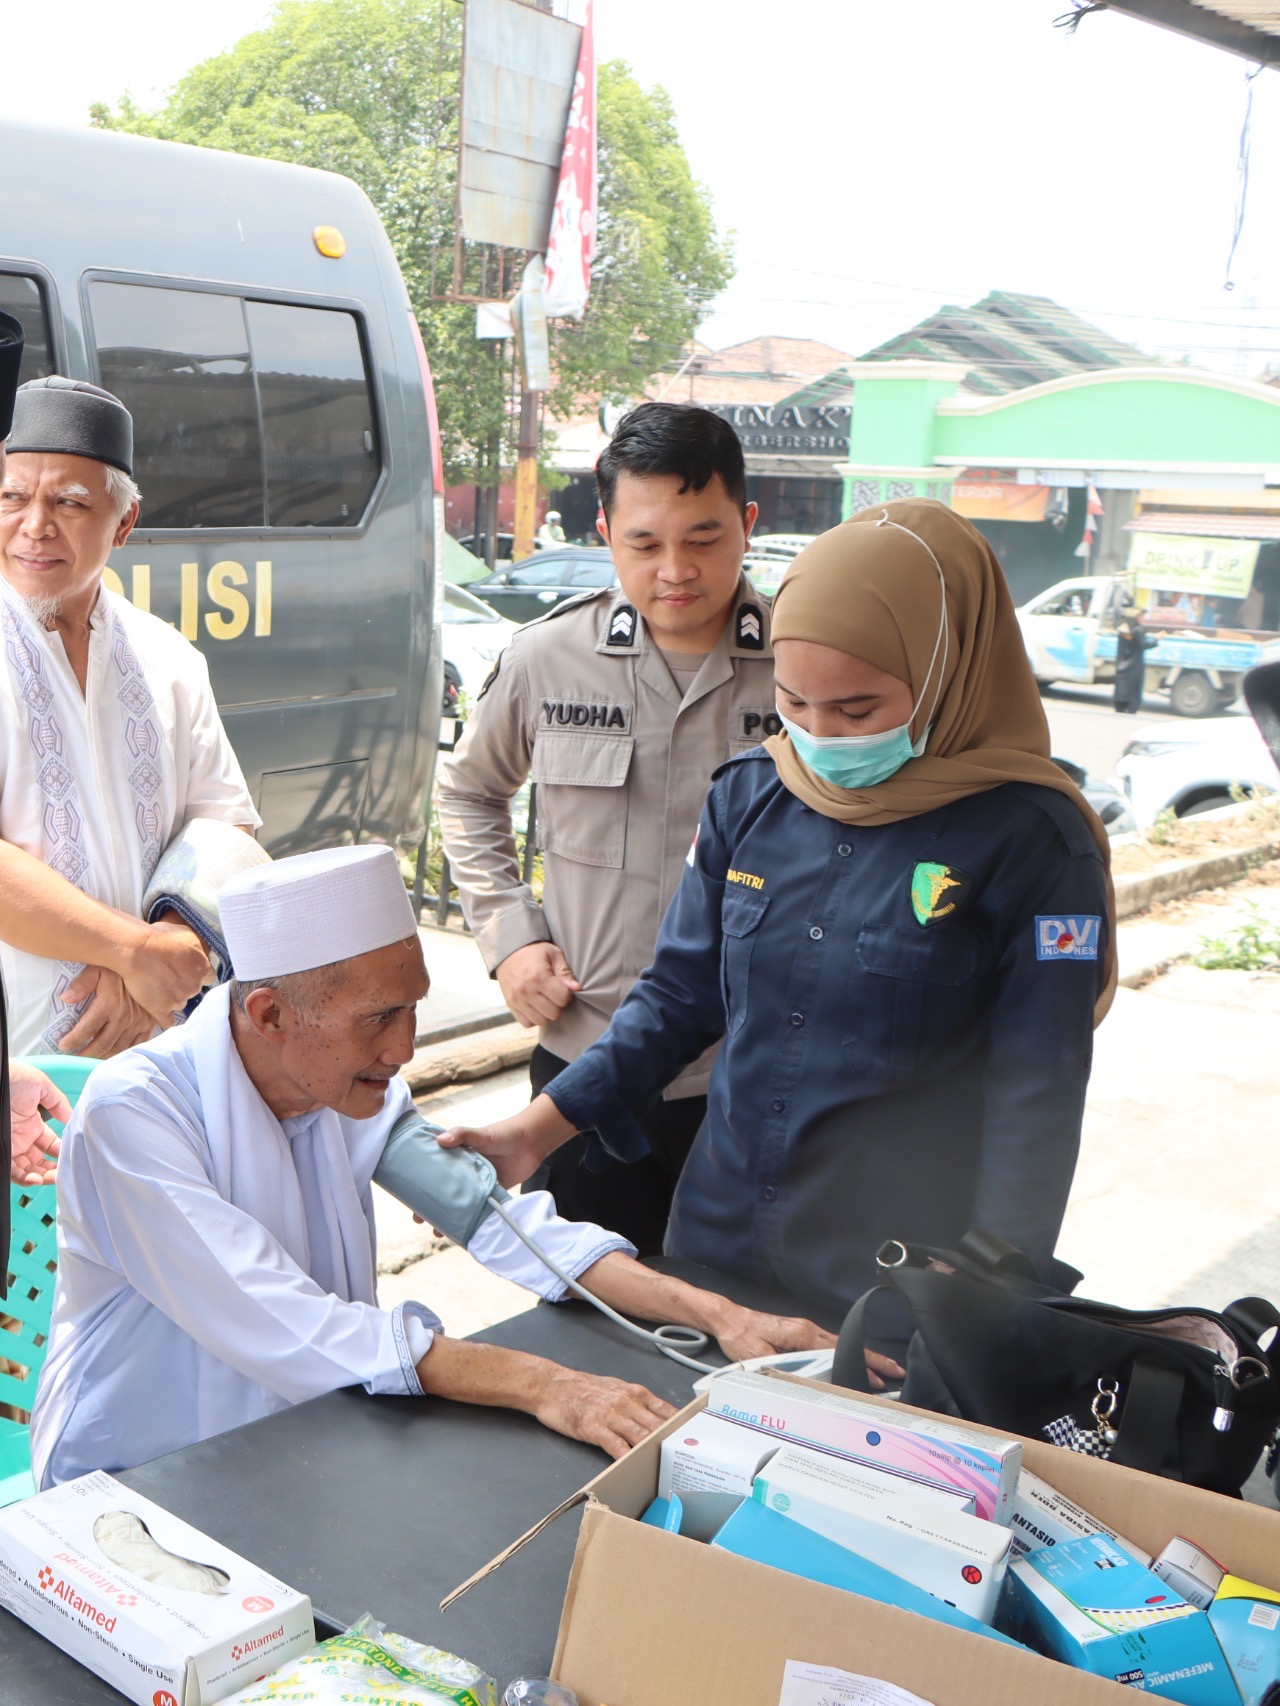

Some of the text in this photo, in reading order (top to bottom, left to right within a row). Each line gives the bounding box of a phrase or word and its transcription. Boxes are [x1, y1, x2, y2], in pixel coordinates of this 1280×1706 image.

[104, 560, 272, 641] LISI
[543, 702, 625, 729] YUDHA
[743, 712, 783, 737] PO
[721, 1404, 786, 1431] Rama FLU
[963, 1459, 972, 1468] 10
[973, 1461, 996, 1473] kaplet
[35, 1518, 58, 1537] Single
[1012, 1513, 1056, 1547] ANTASID
[54, 1552, 117, 1594] Altamed
[53, 1579, 118, 1634] Altamed
[23, 1579, 69, 1618] Ambidextrous
[77, 1619, 120, 1653] Non-Sterile
[128, 1653, 153, 1676] Single
[156, 1669, 174, 1684] Use
[170, 1610, 211, 1640] Powdered
[244, 1625, 285, 1654] Altamed
[1128, 1670, 1144, 1681] 500
[1146, 1661, 1214, 1688] MEFENAMIC
[460, 1695, 473, 1706] H
